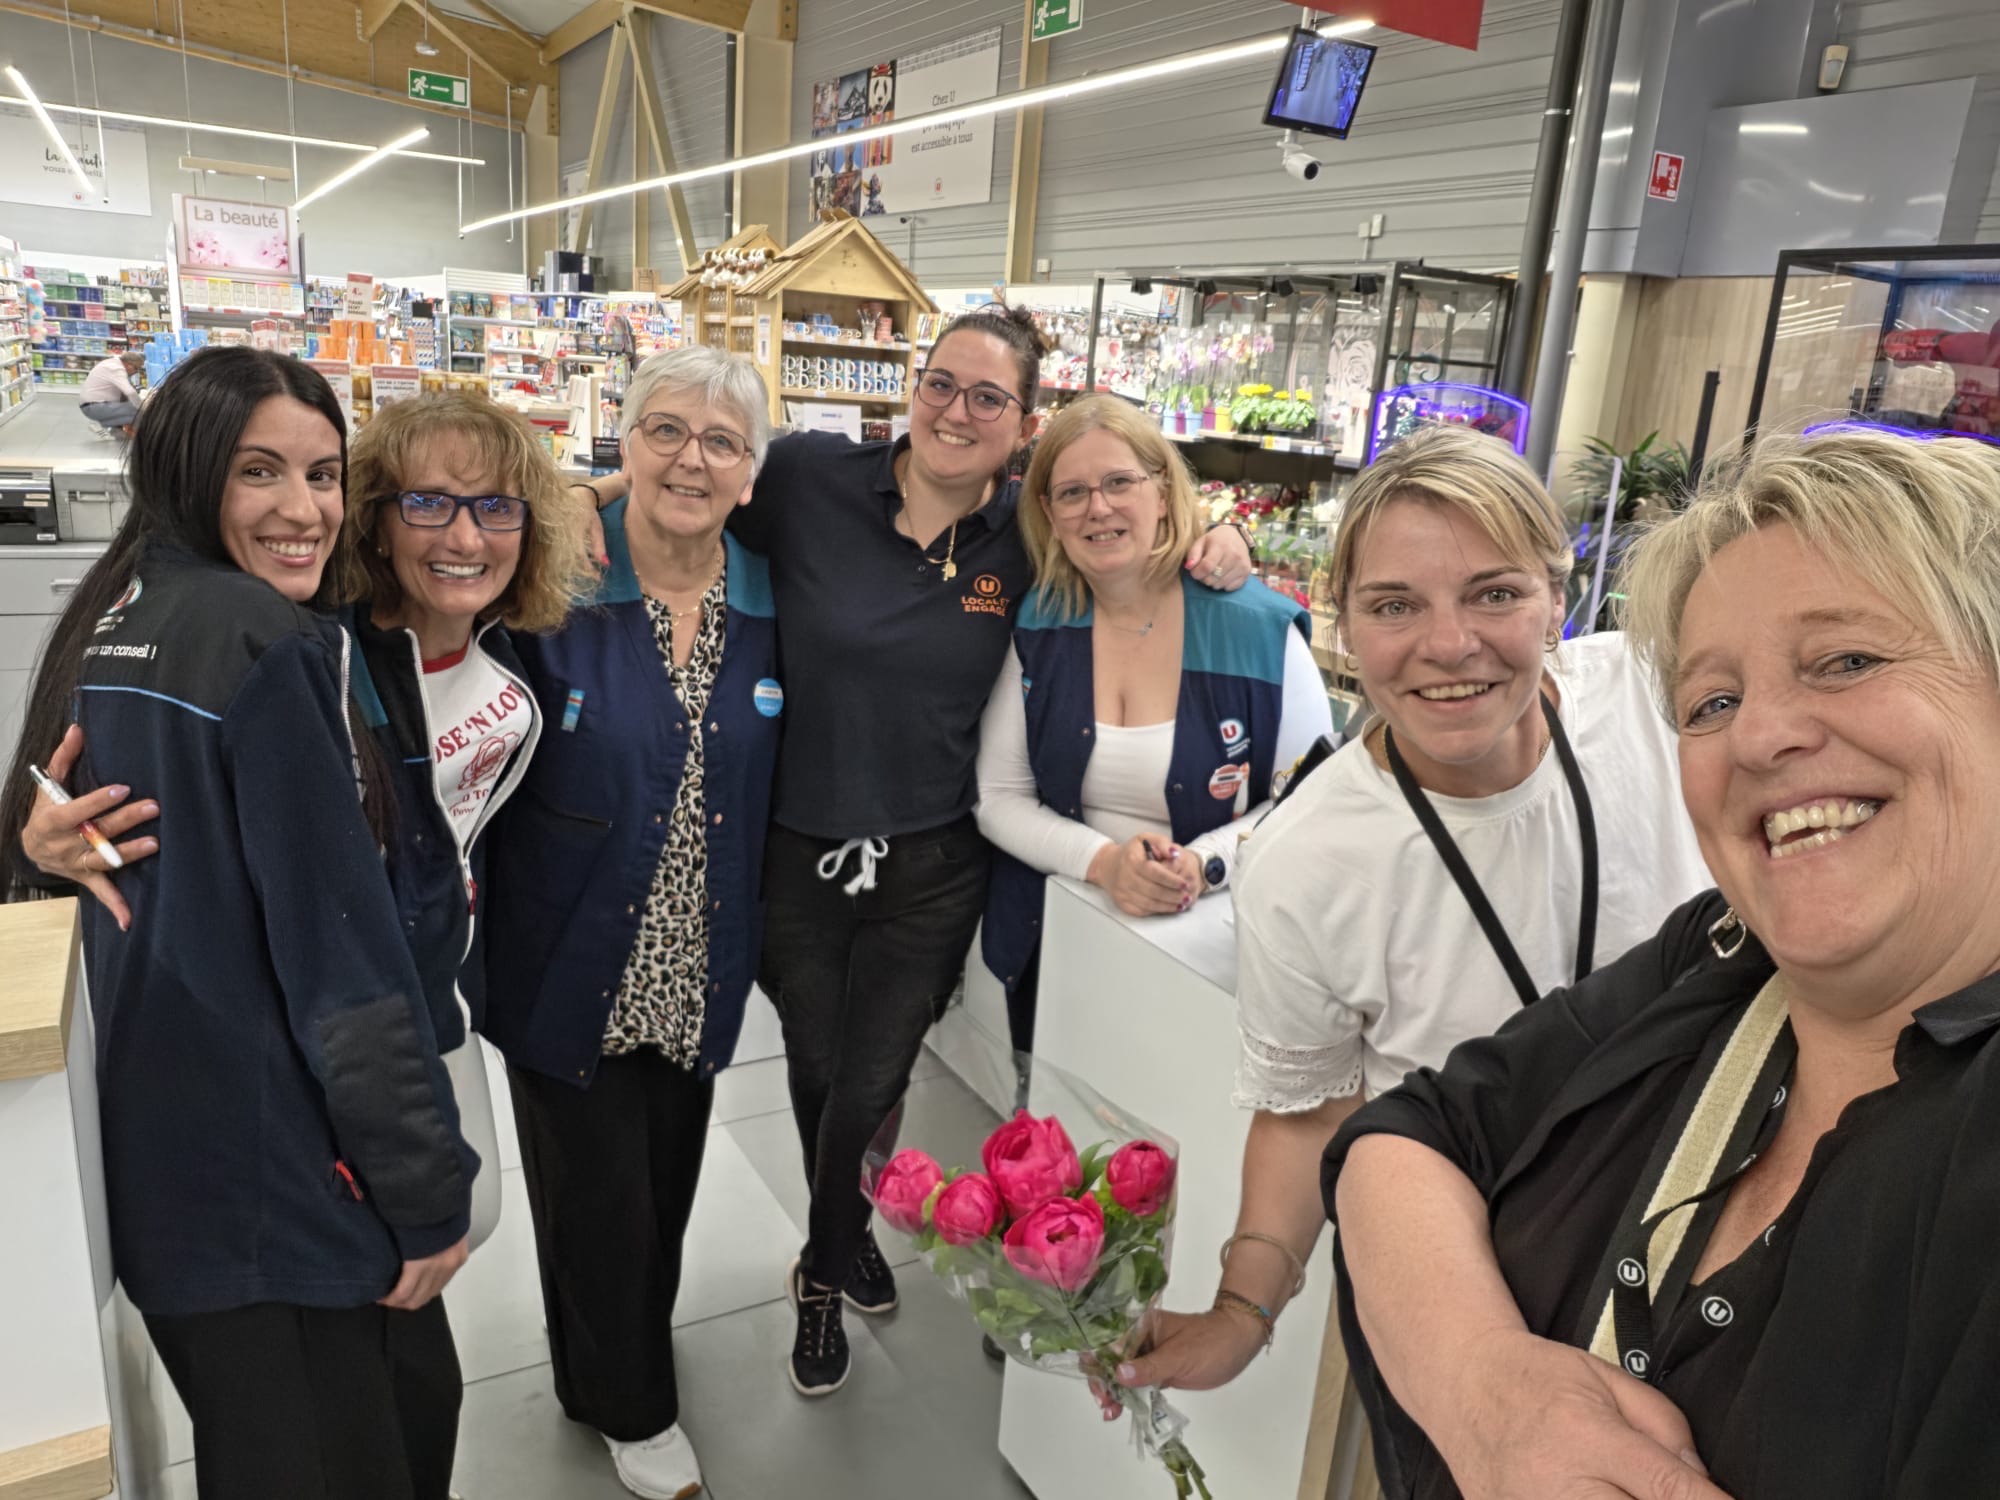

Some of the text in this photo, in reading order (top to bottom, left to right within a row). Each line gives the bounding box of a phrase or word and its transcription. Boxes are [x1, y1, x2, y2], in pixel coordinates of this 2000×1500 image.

[194, 205, 279, 229] La beauté
[113, 644, 150, 658] conseil
